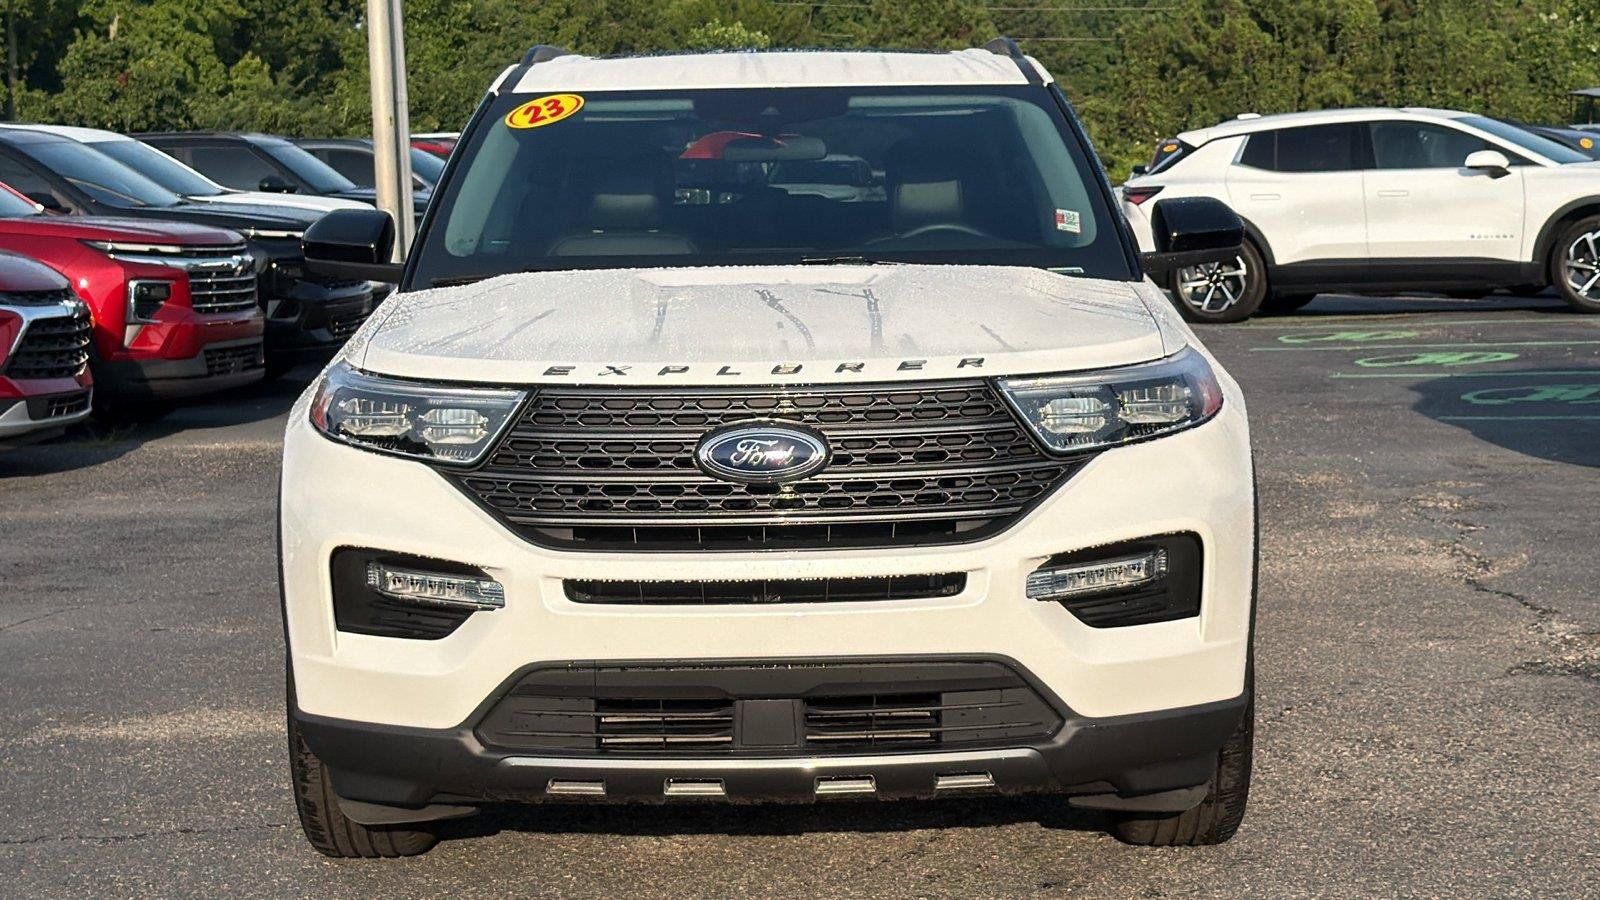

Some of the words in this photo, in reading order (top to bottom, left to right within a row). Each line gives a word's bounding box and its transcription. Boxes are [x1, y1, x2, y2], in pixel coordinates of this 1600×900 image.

[523, 98, 565, 124] 23
[542, 356, 986, 376] EXPLORER
[730, 439, 796, 467] Ford
